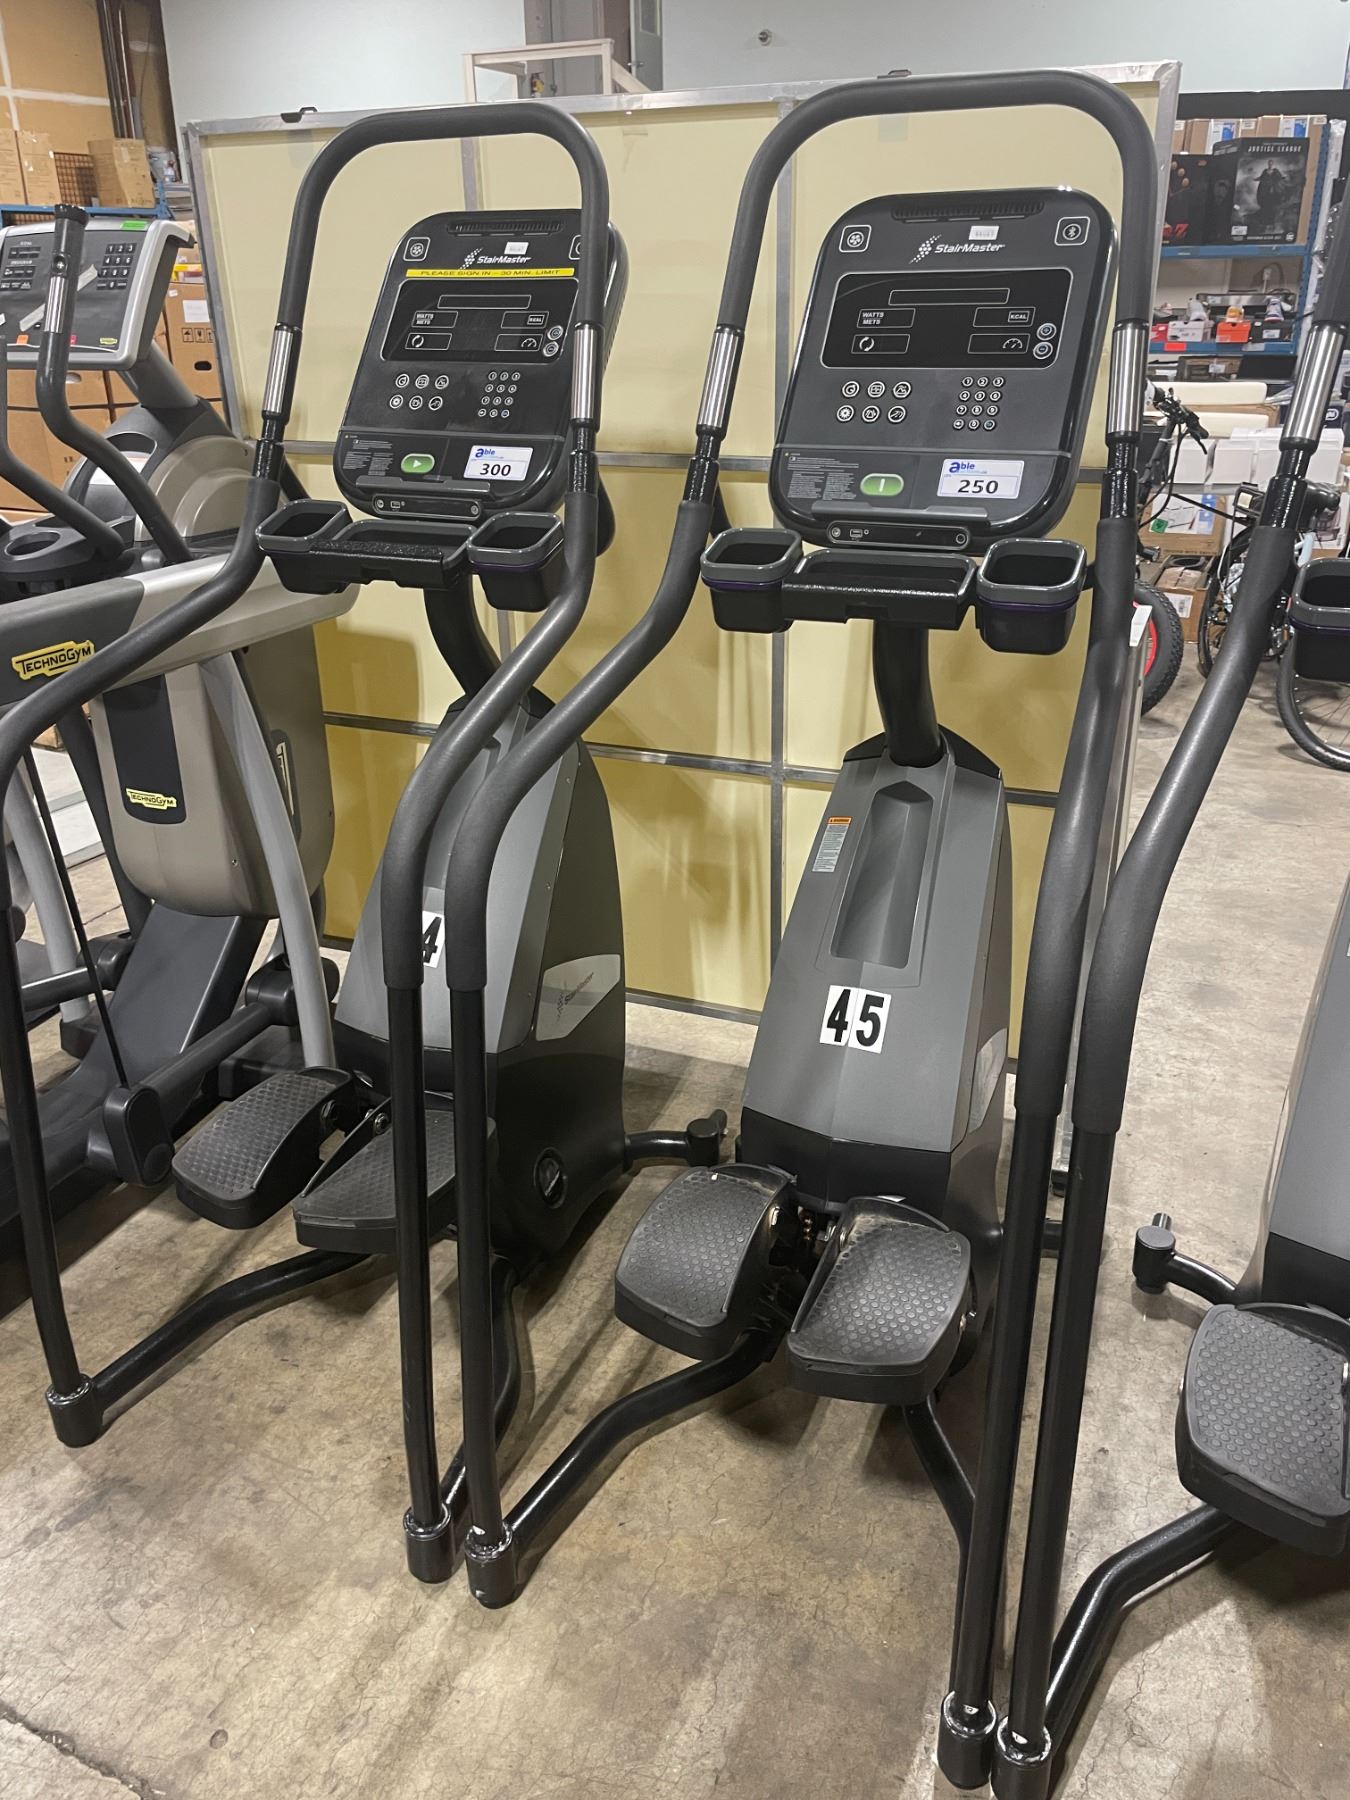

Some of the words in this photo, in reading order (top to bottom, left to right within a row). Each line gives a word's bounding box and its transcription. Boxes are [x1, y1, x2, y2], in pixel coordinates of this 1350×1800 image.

[934, 243, 1005, 253] StairMaster
[477, 255, 532, 264] StairMaster
[475, 448, 496, 458] able
[480, 463, 511, 476] 300
[949, 461, 975, 473] able
[958, 480, 998, 494] 250
[422, 916, 442, 963] 4
[827, 988, 885, 1047] 45
